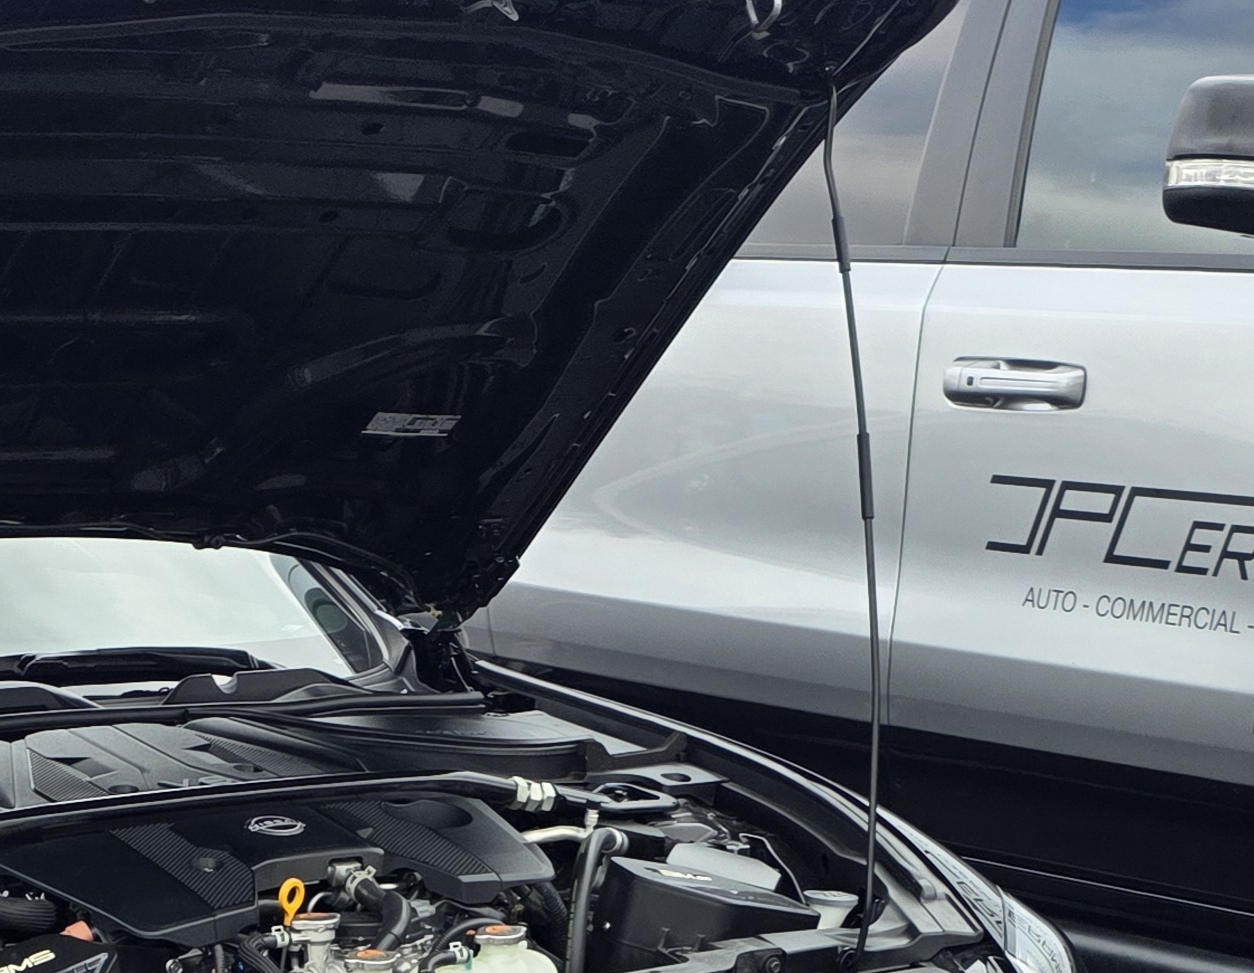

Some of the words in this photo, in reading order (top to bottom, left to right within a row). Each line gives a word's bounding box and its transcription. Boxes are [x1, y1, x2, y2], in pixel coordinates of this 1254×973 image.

[984, 473, 1254, 581] JPCER
[1022, 586, 1077, 613] AUTO
[1095, 594, 1241, 634] COMMERCIAL
